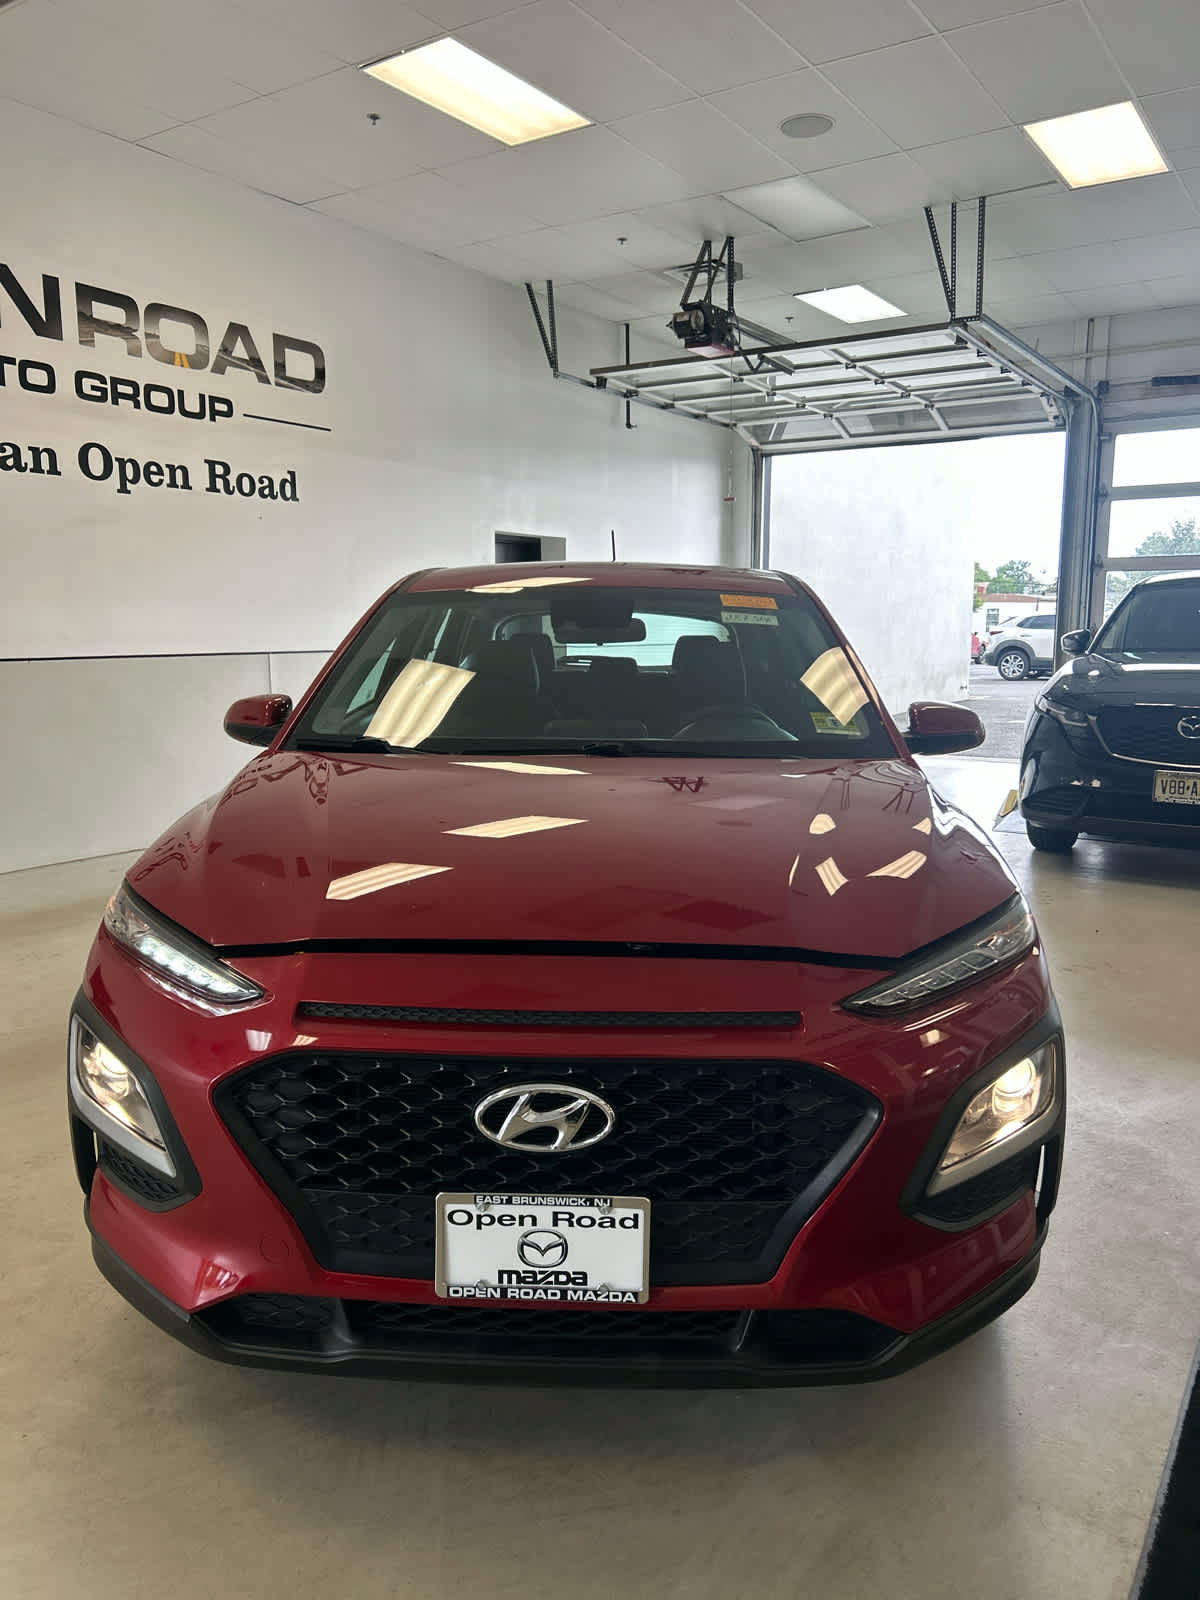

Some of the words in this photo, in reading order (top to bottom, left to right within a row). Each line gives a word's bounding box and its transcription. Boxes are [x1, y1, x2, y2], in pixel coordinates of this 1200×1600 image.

[74, 370, 233, 422] GROUP
[78, 442, 192, 494] Open
[204, 459, 299, 502] Road
[475, 1195, 509, 1204] EAST
[594, 1198, 611, 1207] NJ
[447, 1209, 538, 1230] Open
[552, 1211, 639, 1229] Road
[449, 1286, 501, 1298] OPEN
[507, 1288, 561, 1300] ROAD
[567, 1289, 638, 1302] MAZDA
